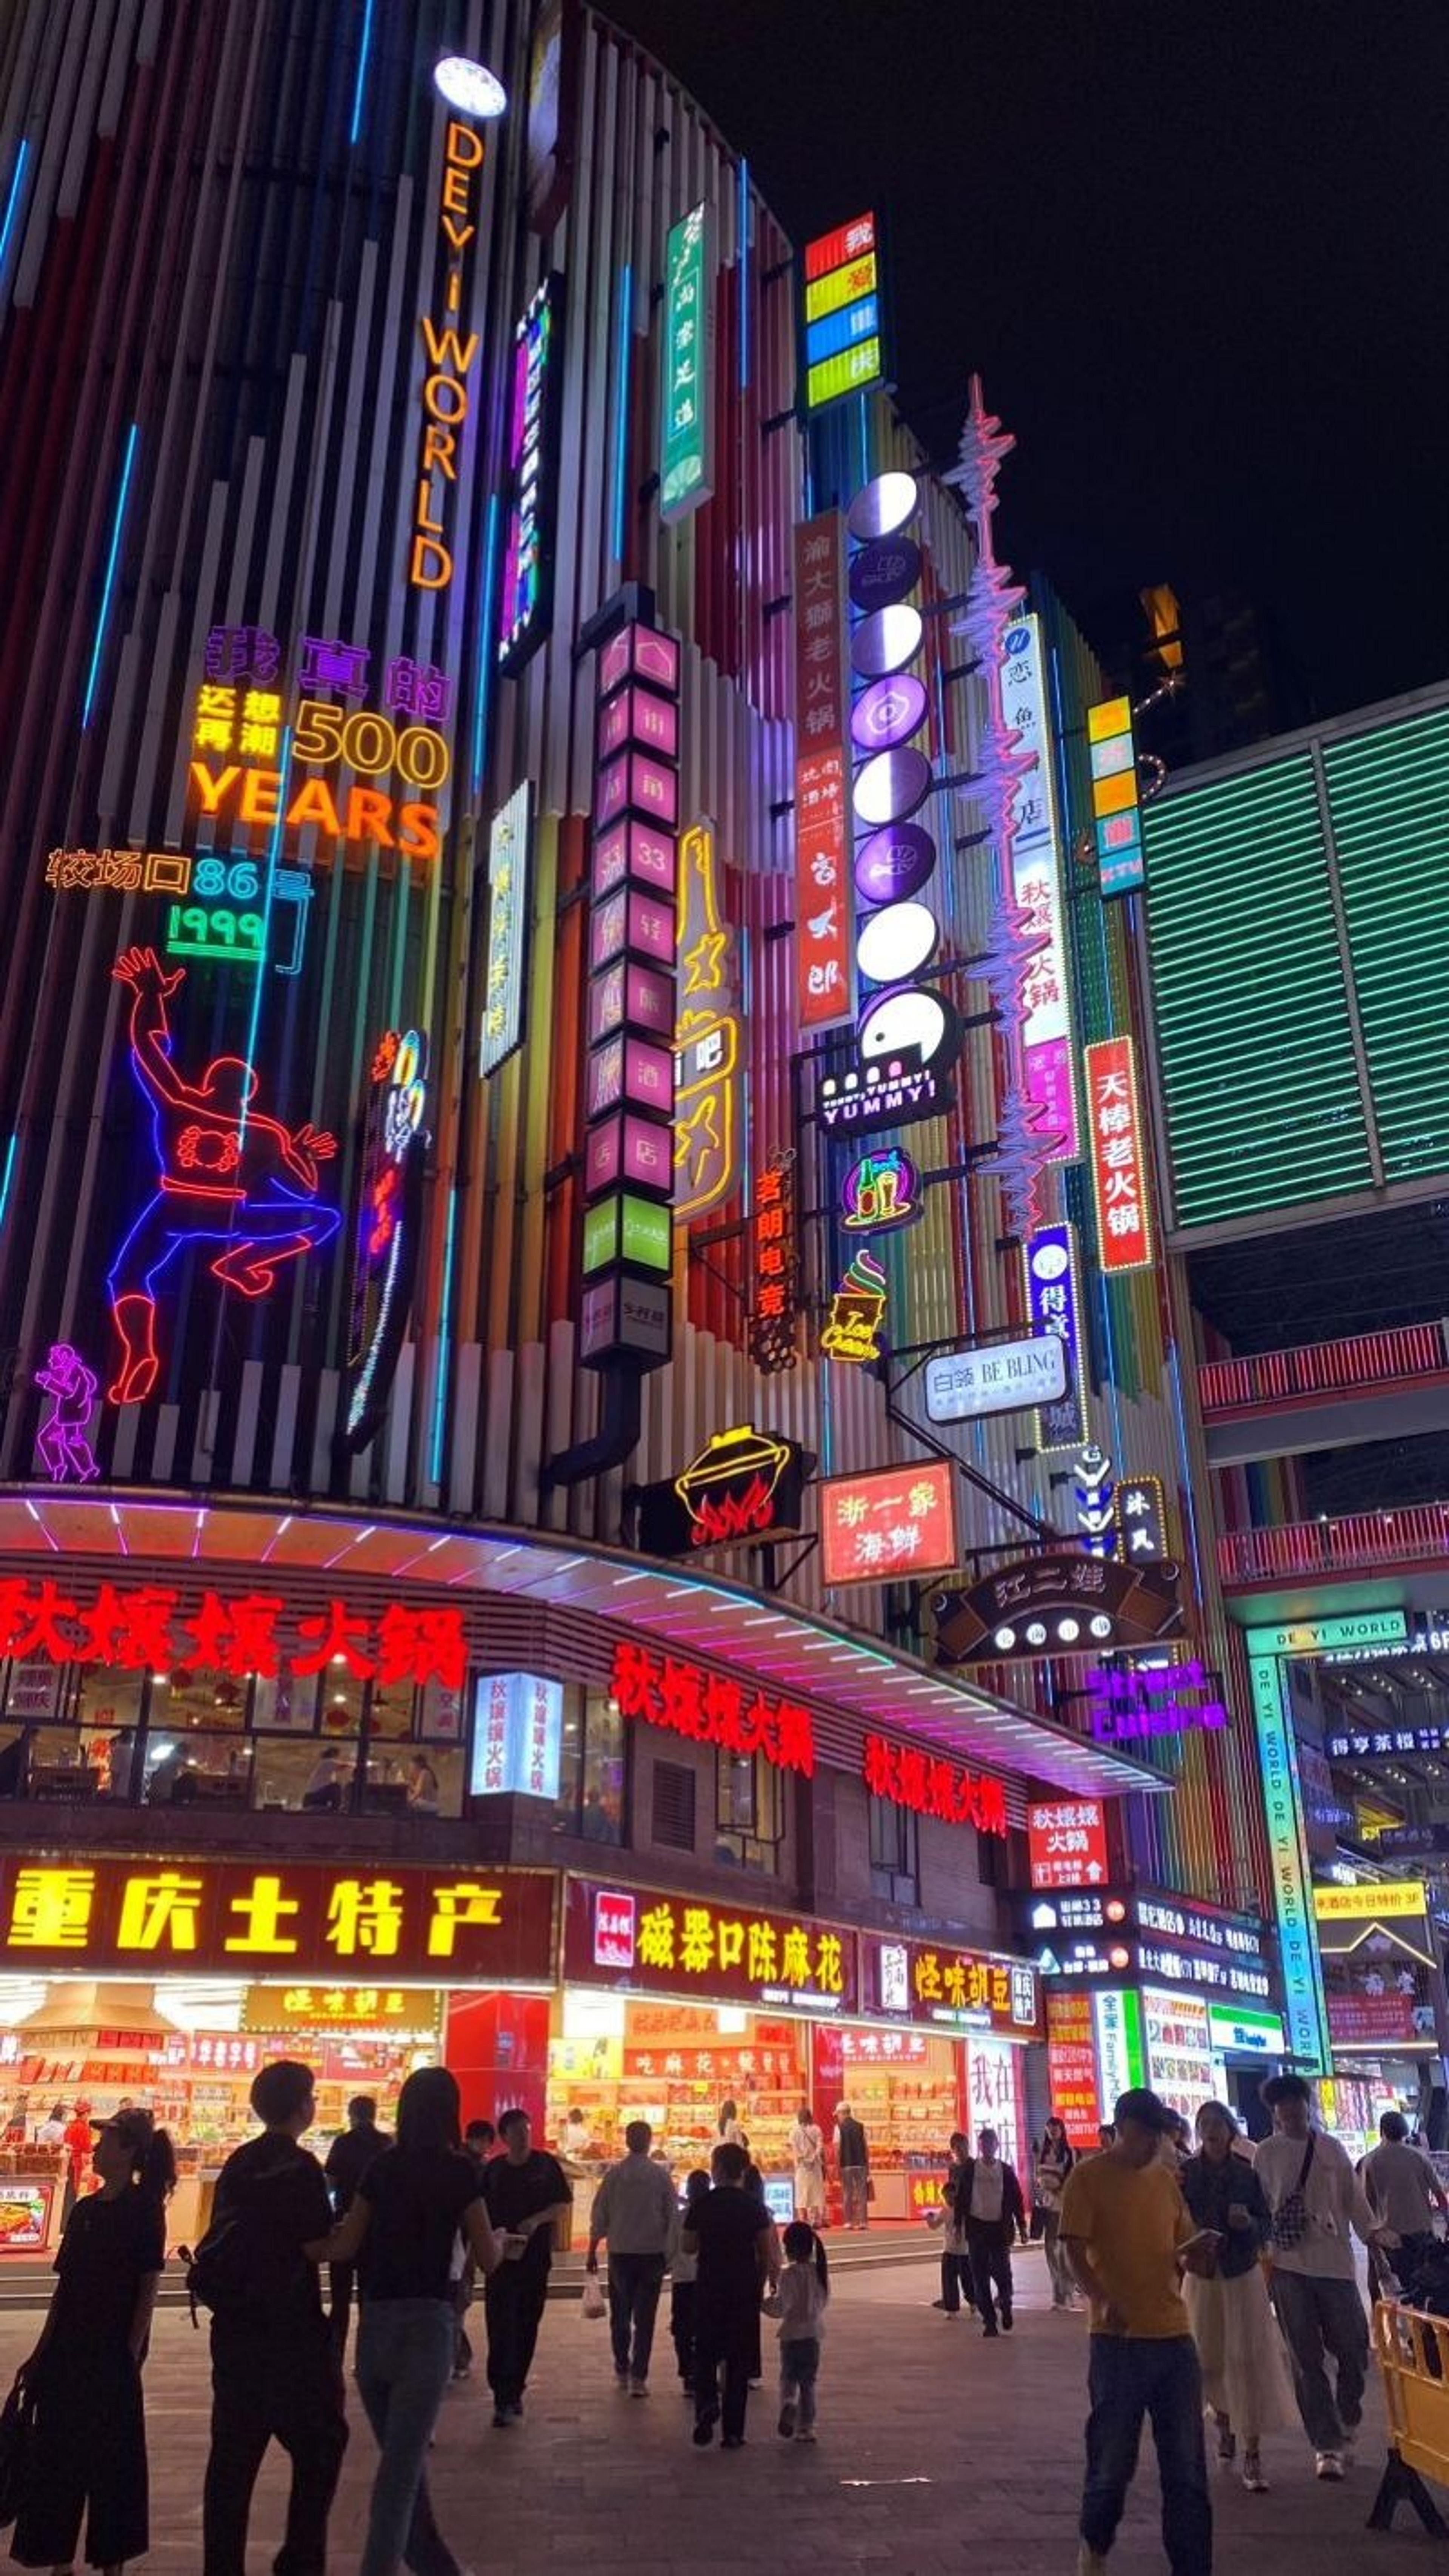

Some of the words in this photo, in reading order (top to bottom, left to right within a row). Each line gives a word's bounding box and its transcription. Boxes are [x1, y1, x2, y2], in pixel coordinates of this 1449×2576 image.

[411, 316, 481, 591] WORLD
[203, 624, 451, 722] 我真的
[196, 684, 282, 723] 还想
[291, 698, 451, 790] 500
[1007, 659, 1043, 825] 恋鱼店
[189, 759, 442, 863] YEARS
[166, 904, 265, 944] 1999
[823, 1079, 936, 1126] YUMMY!
[982, 1362, 1003, 1383] BE
[1007, 1349, 1055, 1380] BLING
[1311, 1628, 1327, 1641] YI
[1340, 1620, 1400, 1637] WORLD
[1258, 1670, 1271, 1690] DE
[1261, 1702, 1274, 1720] YI
[1265, 1731, 1282, 1791] WORLD
[7, 1868, 503, 1957] 重庆土特产
[1280, 1865, 1297, 1928] WORLD
[636, 1902, 844, 1993] 磁器口陈麻花
[283, 1988, 406, 2014] 怪味胡豆
[914, 1951, 1012, 2012] 怪味胡豆
